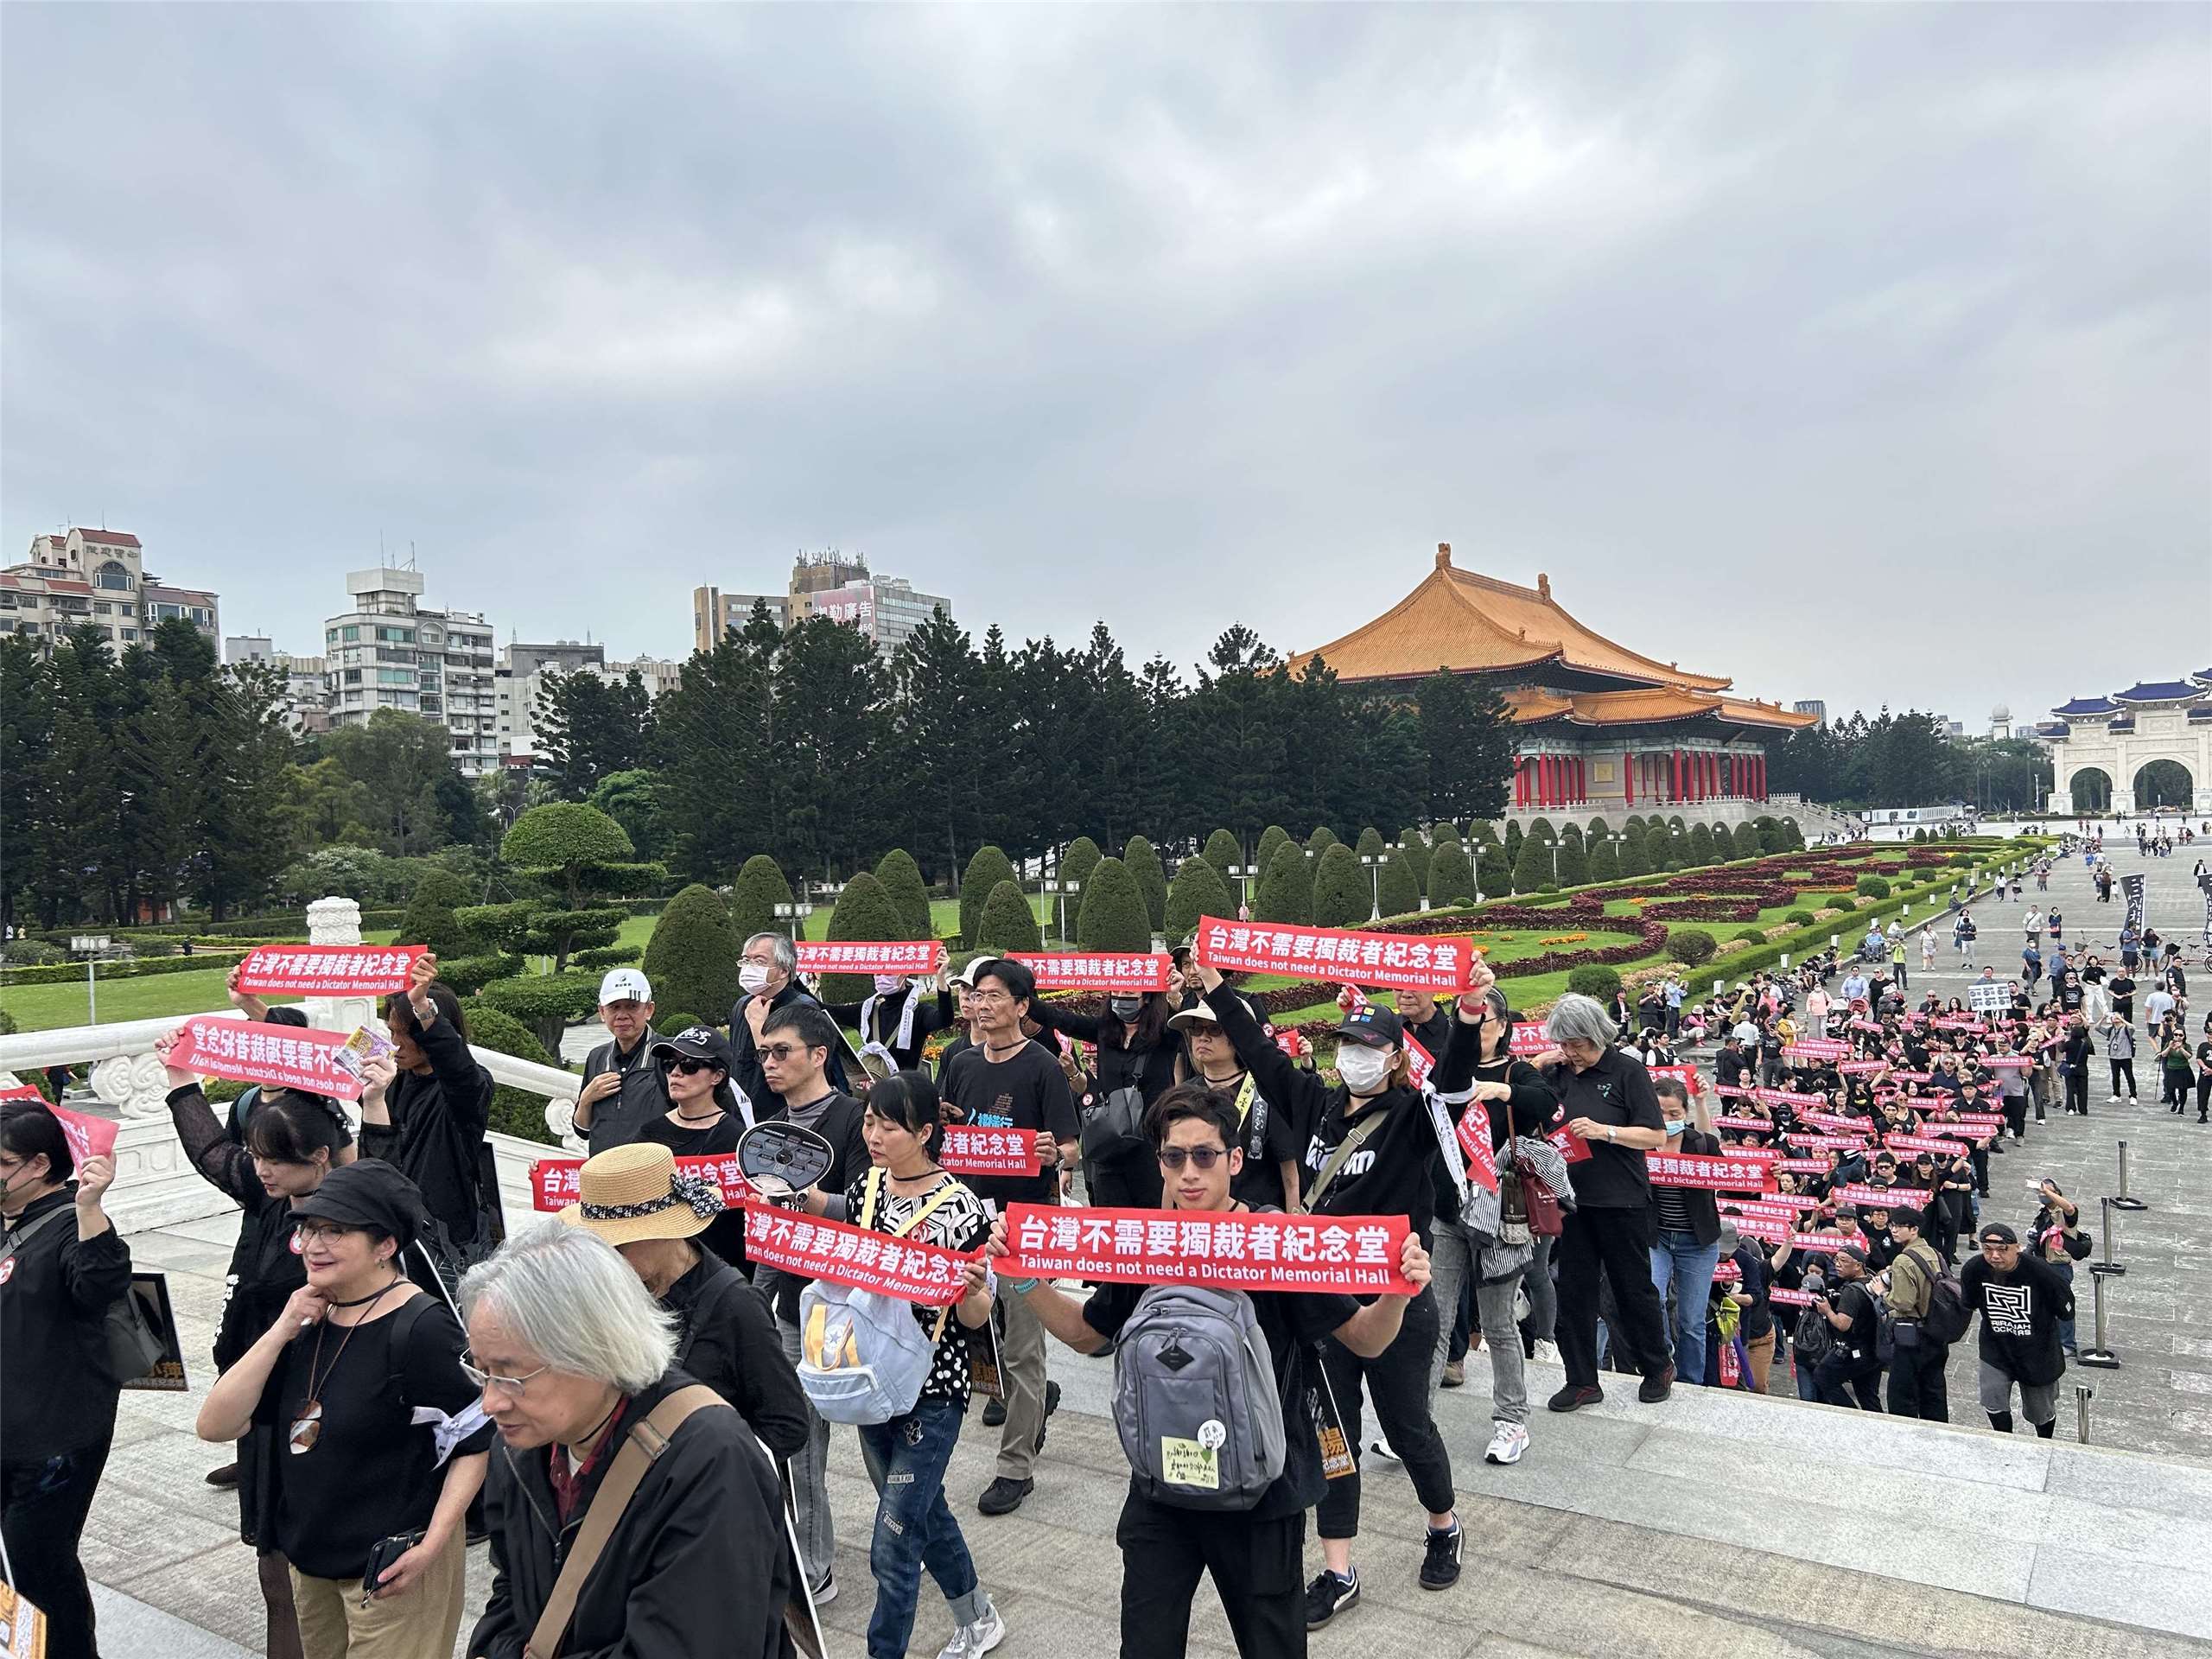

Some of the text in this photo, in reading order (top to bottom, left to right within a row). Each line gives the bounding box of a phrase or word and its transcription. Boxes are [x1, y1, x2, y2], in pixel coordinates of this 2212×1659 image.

[797, 946, 930, 962] 台灣不需要獨裁者紀念堂
[1209, 926, 1458, 972] 台灣不需要獨裁者紀念堂
[247, 952, 410, 976] 台灣不需要獨裁者紀念堂
[1020, 958, 1159, 977] 灣不需要獨裁者紀念堂
[1207, 951, 1456, 987] Taiwan does not need a Dictator Memorial Hall
[244, 977, 267, 987] Taiwan
[268, 978, 284, 988] does
[285, 980, 297, 989] not
[298, 979, 315, 989] need
[322, 979, 352, 989] Dictator
[353, 979, 388, 990] Memorial
[389, 979, 404, 989] Hall
[1457, 1123, 1483, 1157] emorial
[965, 1159, 1006, 1168] Memorial
[1007, 1160, 1027, 1169] Hall
[1646, 1157, 1764, 1179] 要獨裁者紀念堂
[1674, 1176, 1706, 1185] Dictator
[1707, 1179, 1745, 1187] Memorial
[1747, 1179, 1763, 1188] Hall
[543, 1187, 747, 1206] Taiwan Hall
[1019, 1214, 1389, 1264] 台灣不需要獨裁者紀念堂
[763, 1248, 785, 1264] does
[786, 1254, 802, 1268] not
[804, 1259, 827, 1274] need
[830, 1266, 836, 1274] a
[836, 1264, 881, 1286] Dictator
[884, 1276, 939, 1298] Memorial
[1019, 1253, 1389, 1286] Taiwan does not need a Dictator Memorial Hall
